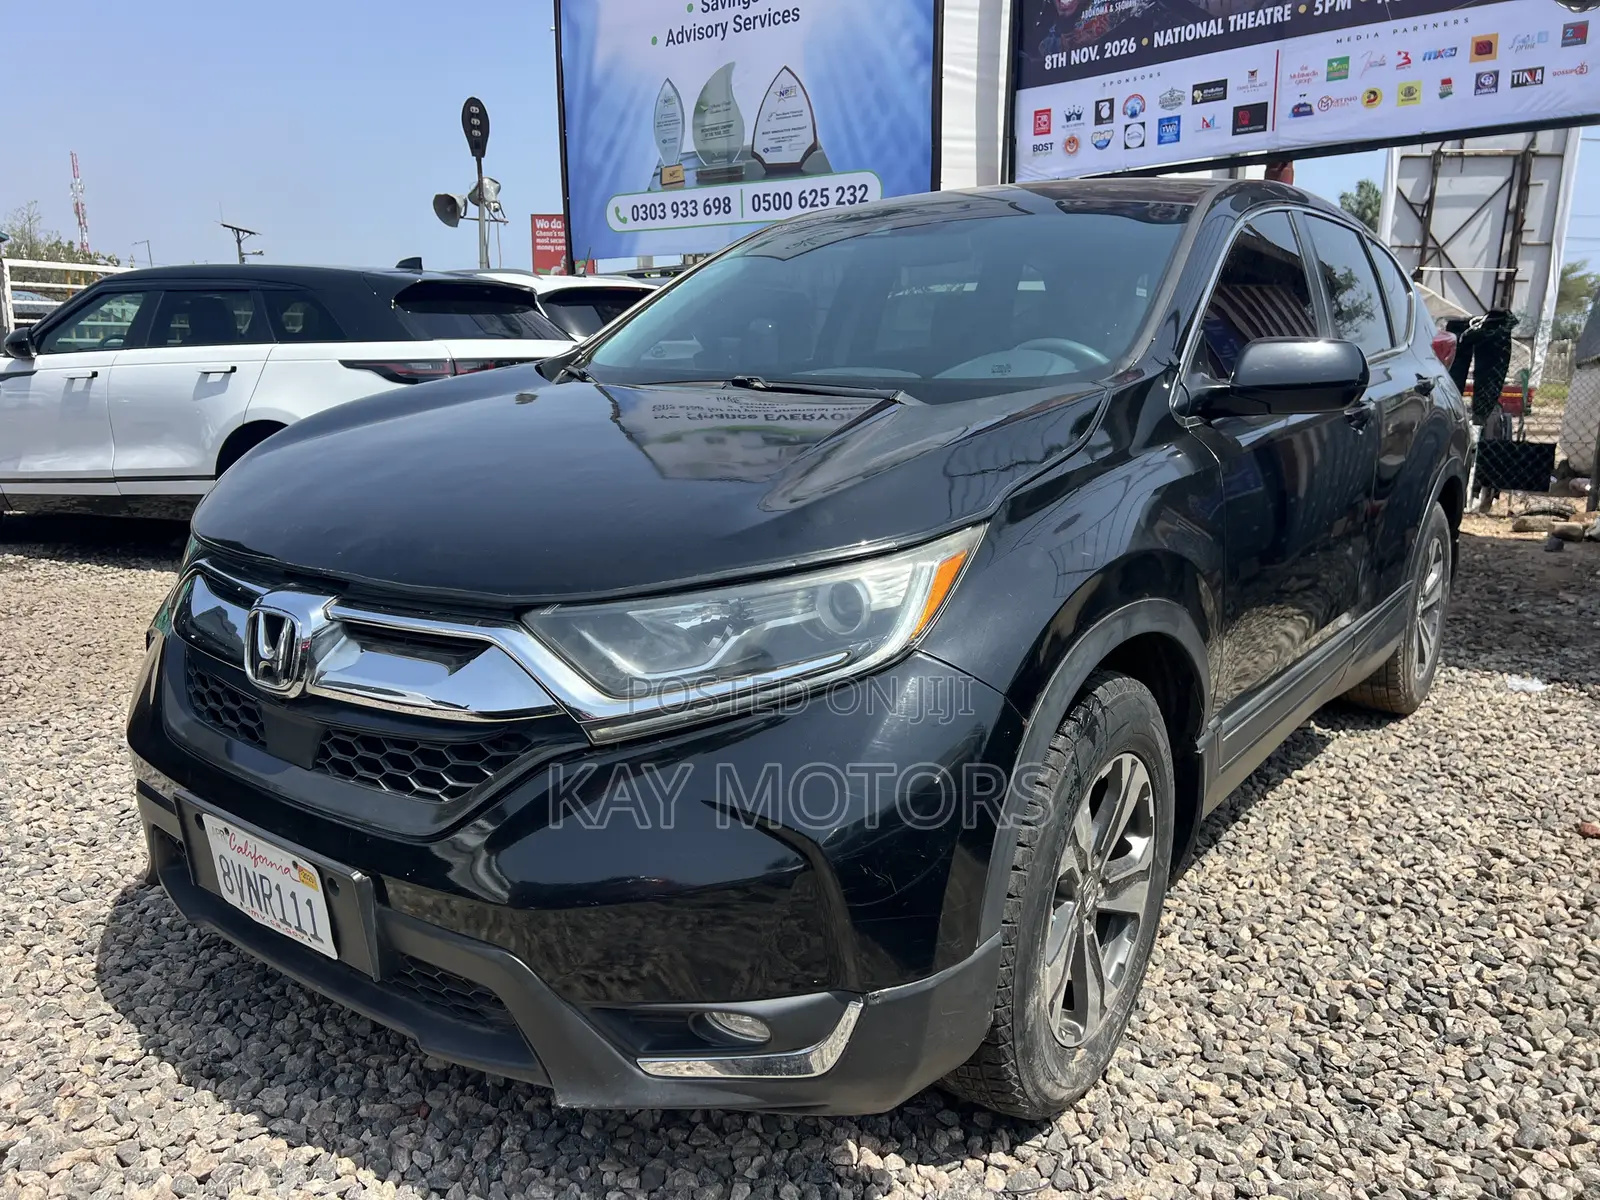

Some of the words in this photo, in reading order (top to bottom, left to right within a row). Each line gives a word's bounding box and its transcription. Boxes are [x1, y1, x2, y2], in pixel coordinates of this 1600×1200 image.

[701, 0, 760, 13] Saving
[665, 22, 728, 47] Advisory
[733, 7, 800, 33] Services
[1044, 51, 1066, 70] 8TH
[1071, 45, 1100, 65] NOV.
[1104, 37, 1136, 58] 2026
[1154, 18, 1224, 48] NATIONAL
[1228, 4, 1291, 32] THEATRE
[1313, 0, 1352, 16] 5PM
[1336, 32, 1380, 44] MEDIA
[1393, 17, 1469, 35] PARTNERS
[1102, 71, 1161, 88] SPONSORS
[1033, 142, 1054, 152] BOST
[631, 203, 667, 222] 0303
[670, 199, 699, 219] 933
[703, 196, 732, 216] 698
[751, 191, 793, 213] 0500
[798, 187, 829, 209] 625
[835, 183, 869, 206] 232
[535, 219, 549, 229] Wo
[550, 218, 562, 229] da
[229, 832, 300, 882] California
[219, 854, 324, 944] 8VNR111
